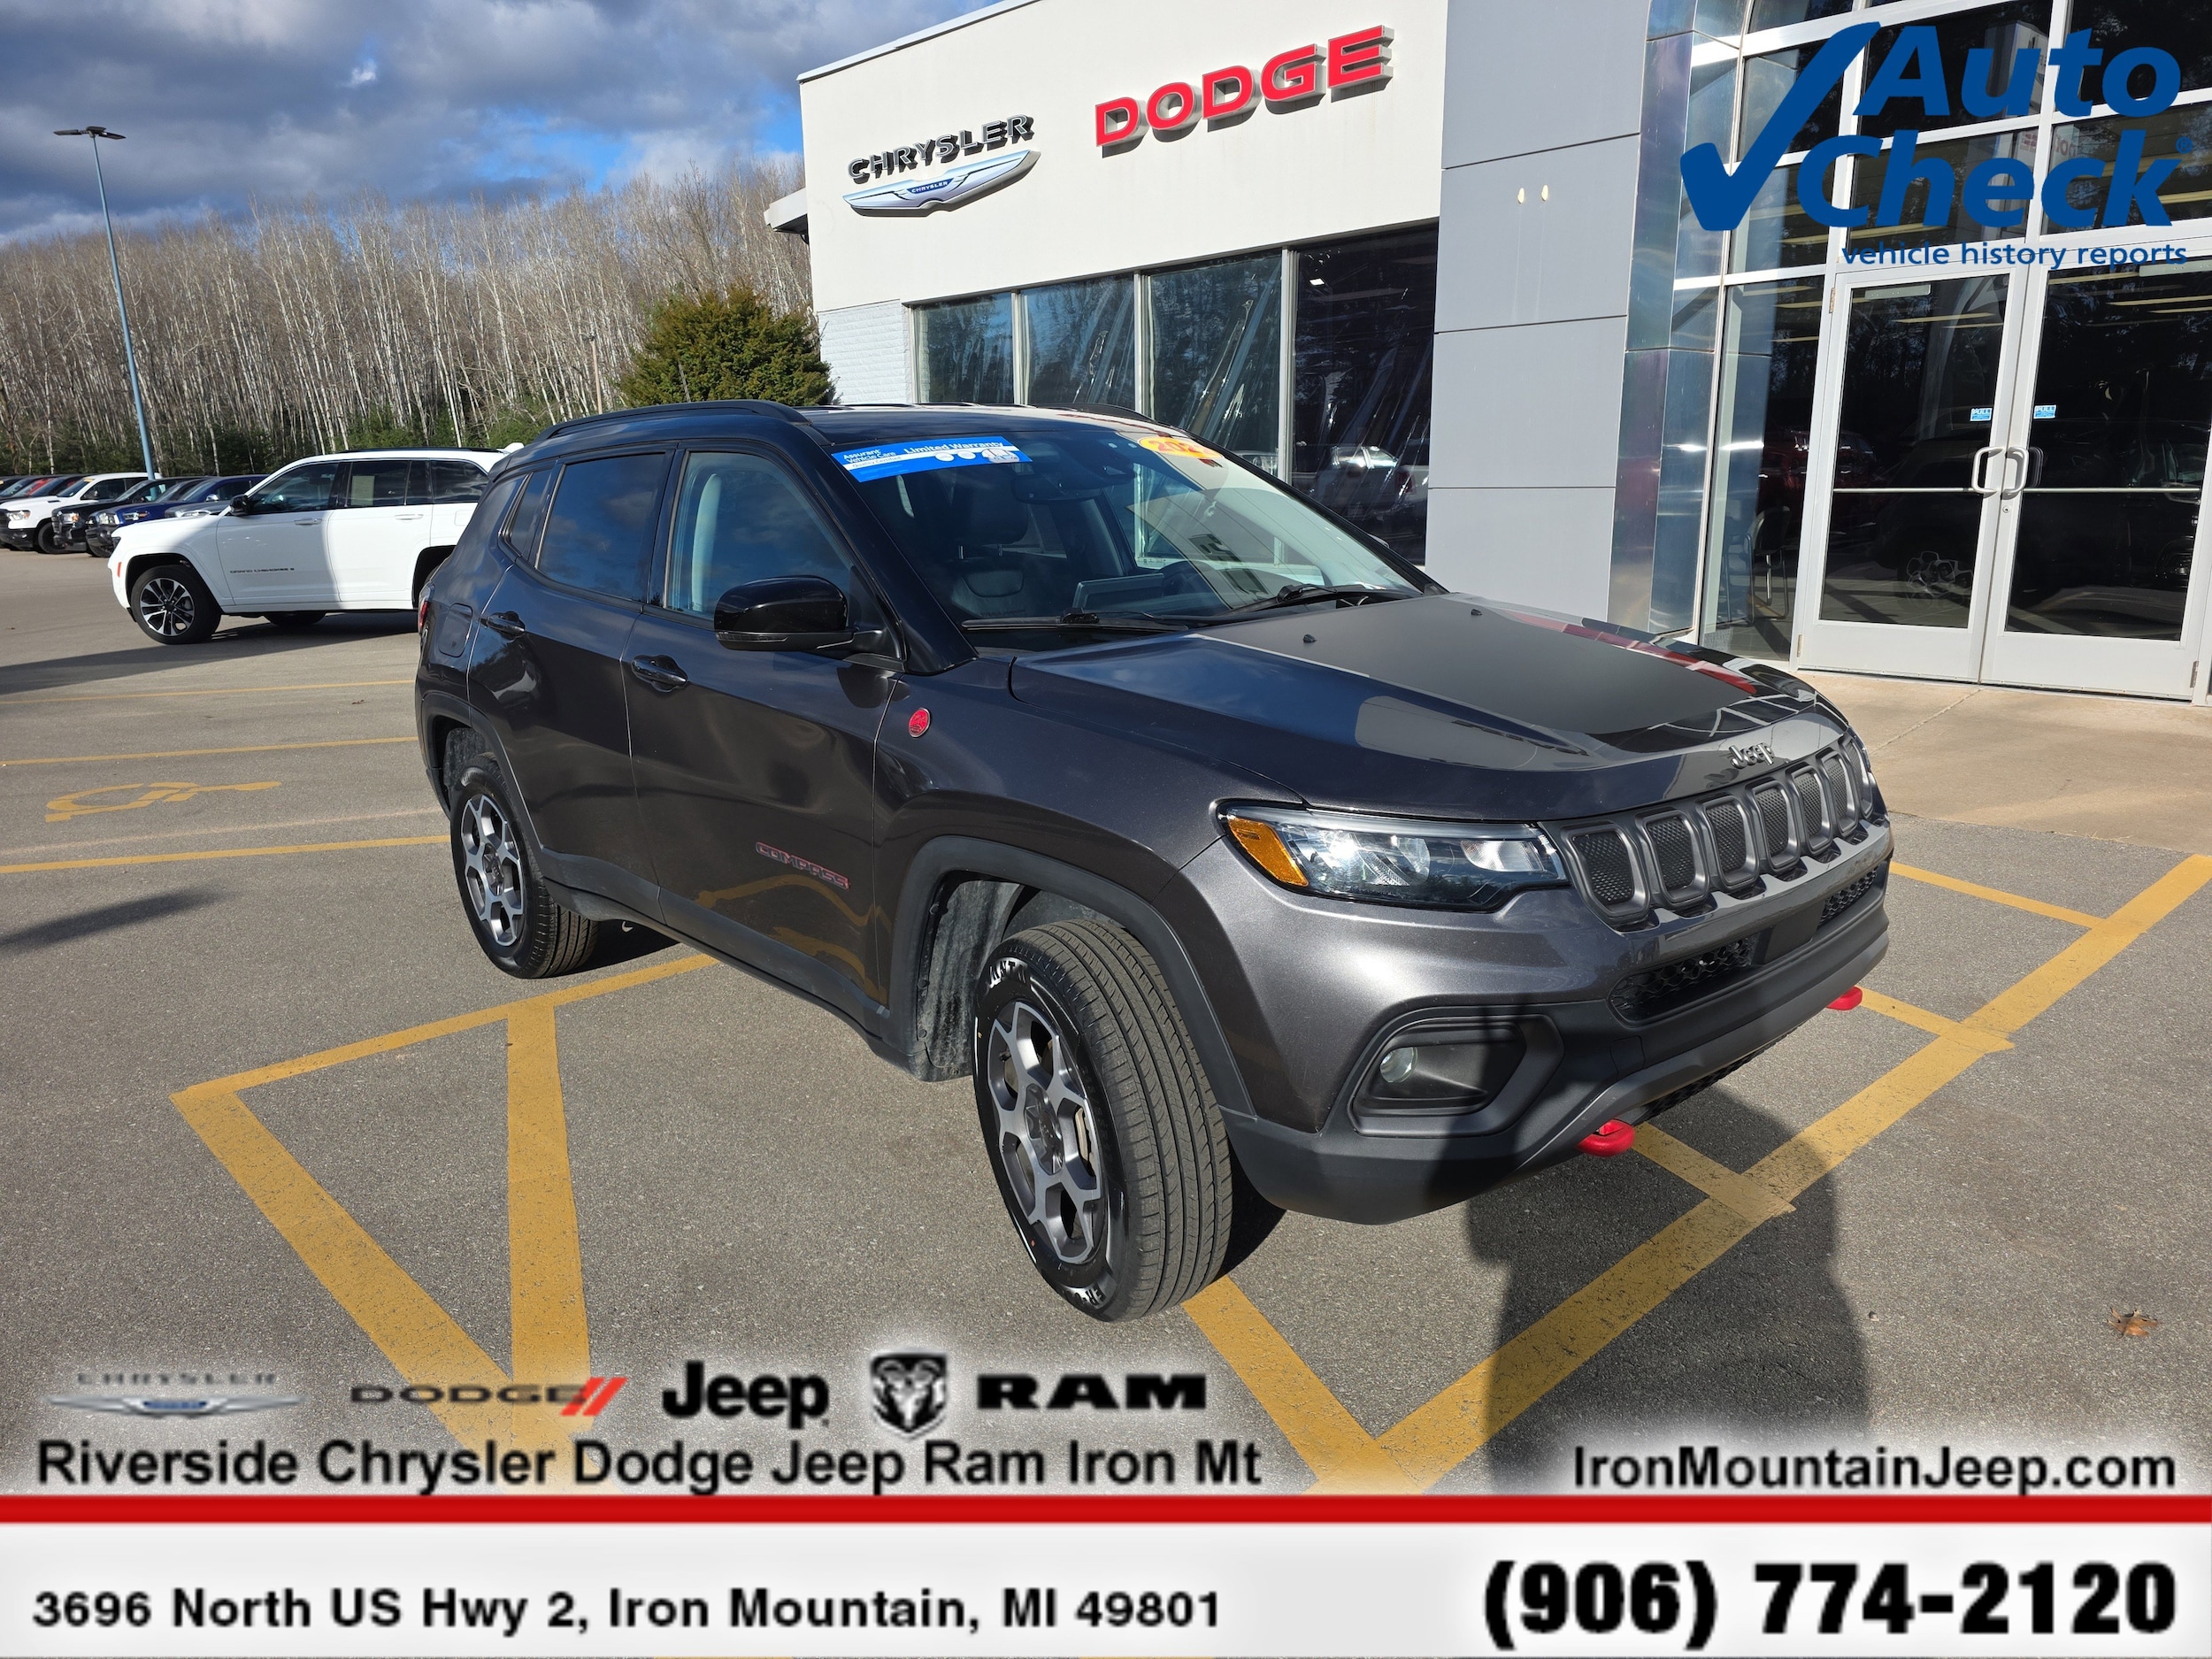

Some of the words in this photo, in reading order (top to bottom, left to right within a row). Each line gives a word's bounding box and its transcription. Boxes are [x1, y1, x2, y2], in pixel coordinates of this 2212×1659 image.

[1094, 25, 1389, 150] DODGE
[848, 113, 1034, 182] CHRYSLER
[910, 180, 949, 193] CHRYSLER
[843, 449, 880, 460] Assurant
[903, 443, 950, 455] Limited
[1728, 742, 1774, 769] Jeep
[756, 841, 850, 891] COMPASS
